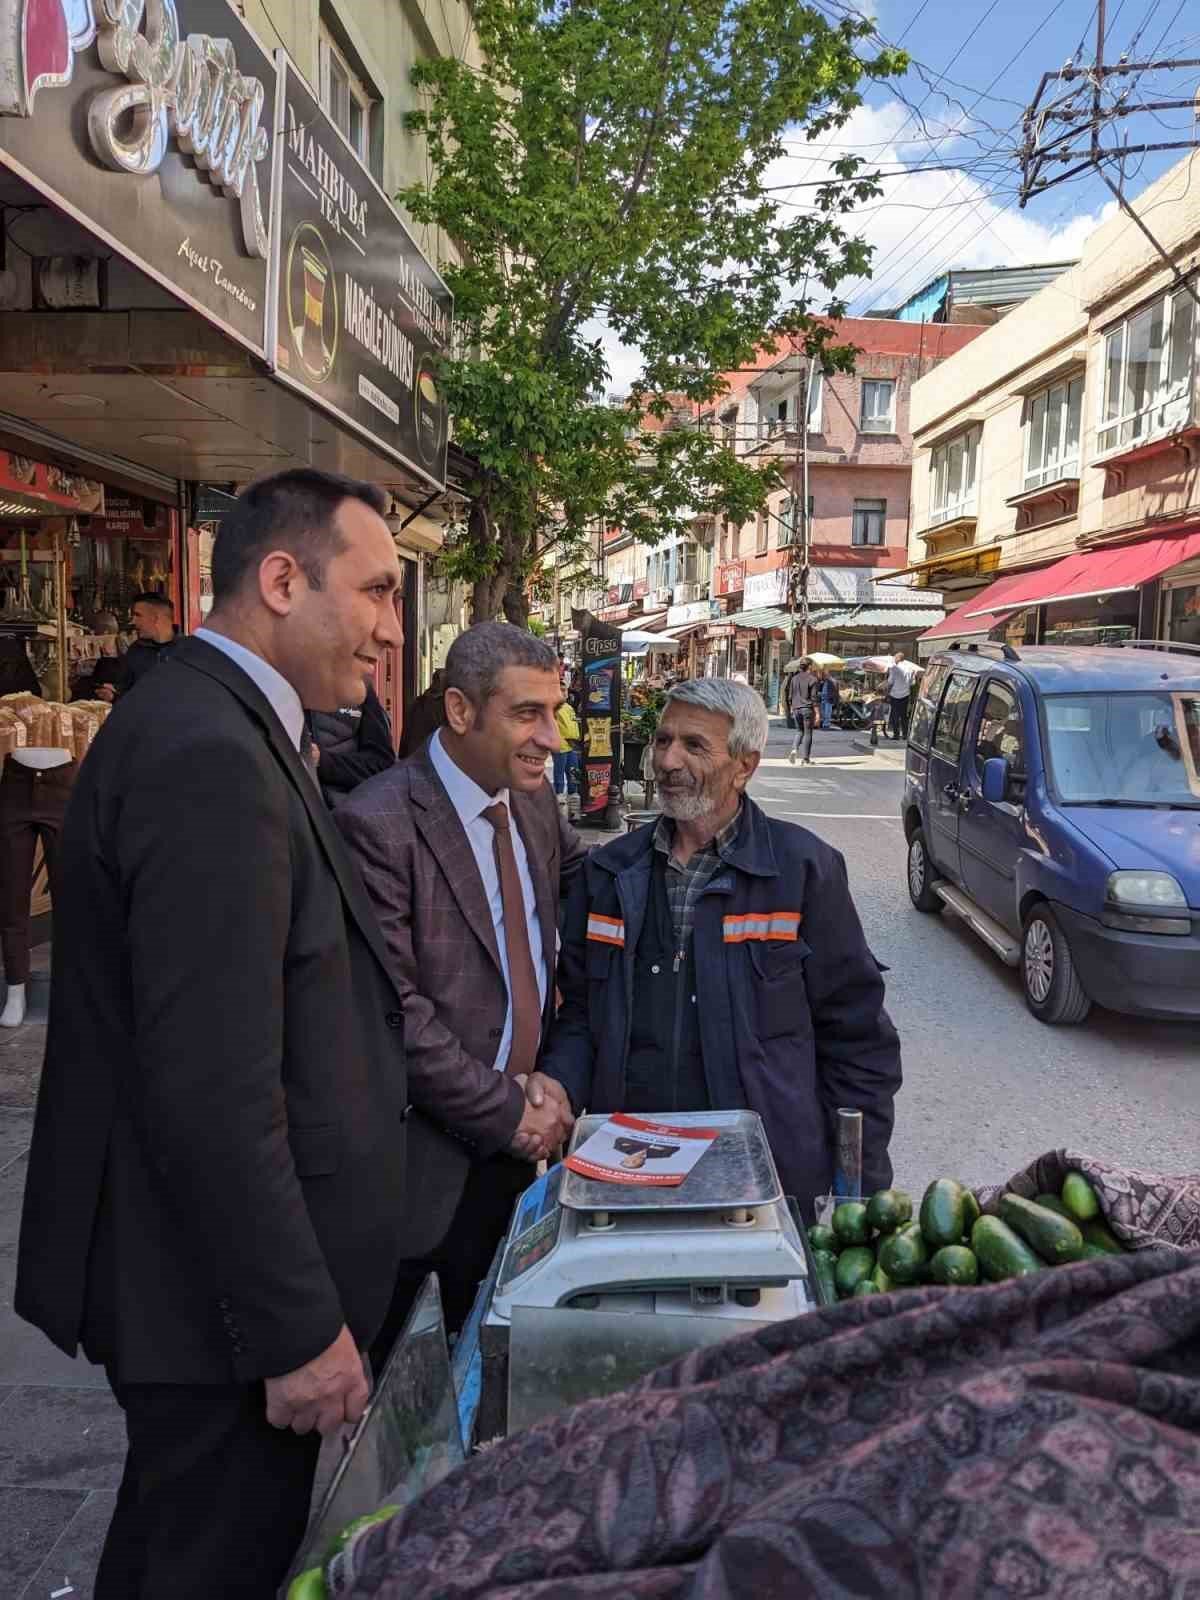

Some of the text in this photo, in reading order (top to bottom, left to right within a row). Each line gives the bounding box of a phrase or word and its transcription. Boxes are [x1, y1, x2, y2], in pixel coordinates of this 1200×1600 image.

[288, 103, 367, 238] MAHBUBA
[320, 188, 341, 235] TEA
[345, 273, 382, 361] NARGİLE
